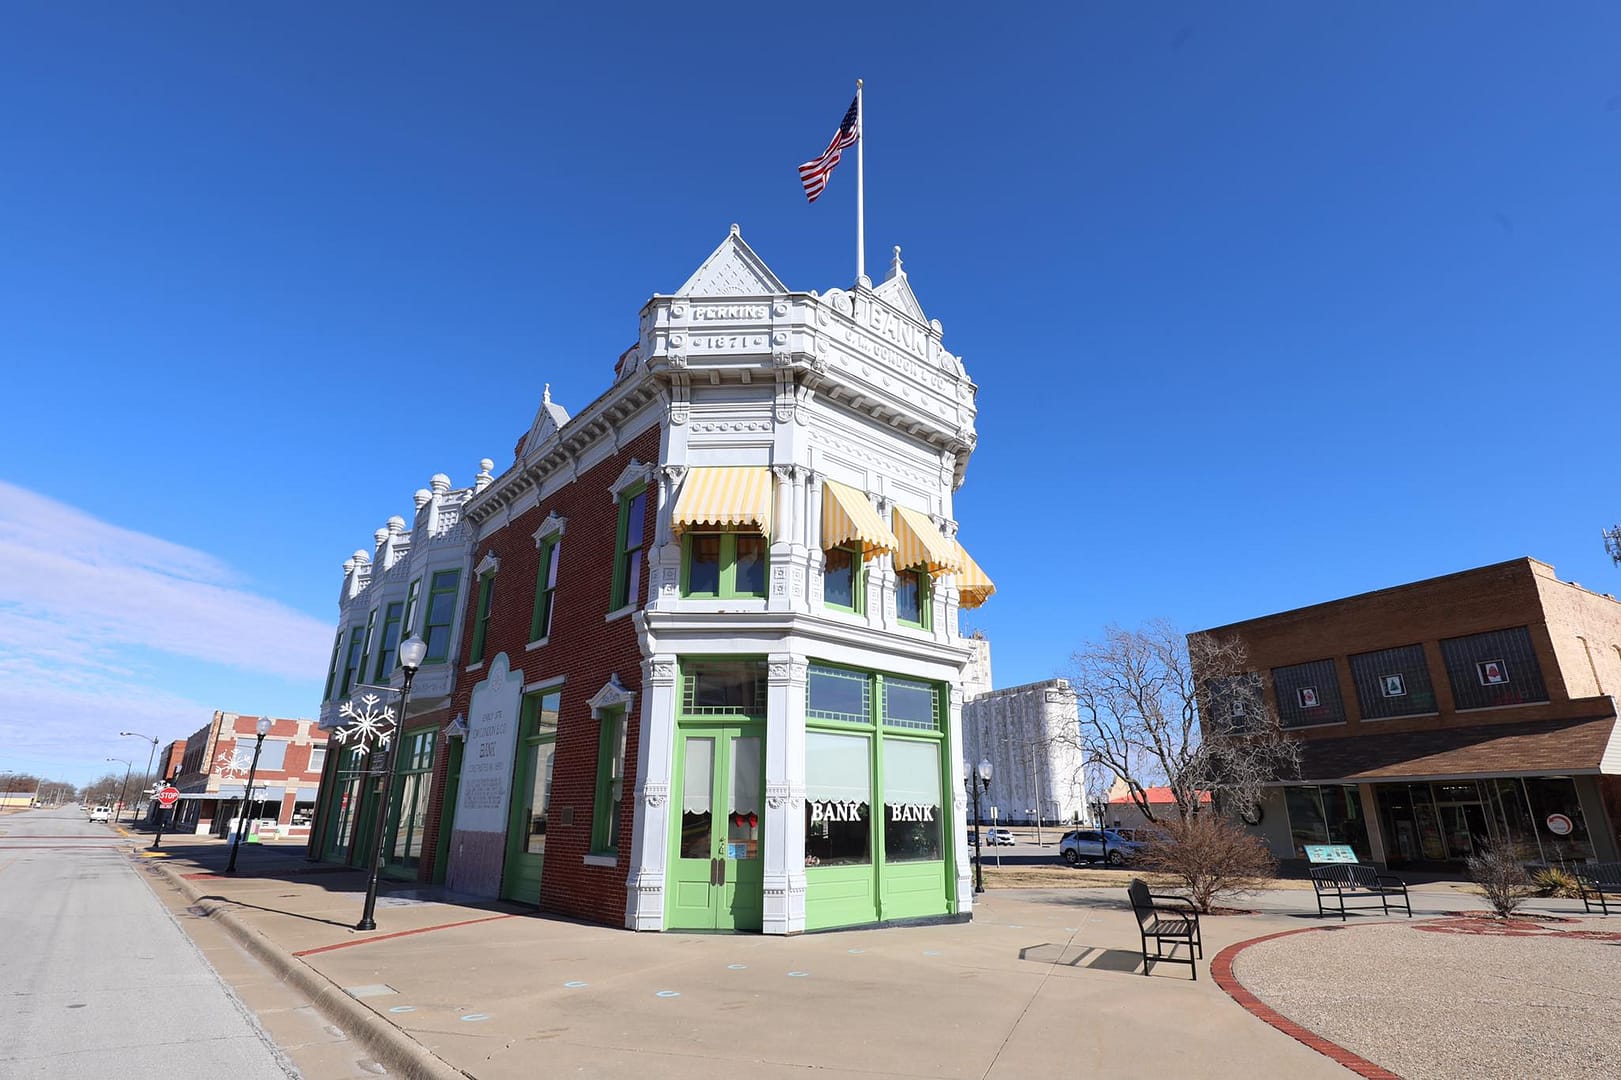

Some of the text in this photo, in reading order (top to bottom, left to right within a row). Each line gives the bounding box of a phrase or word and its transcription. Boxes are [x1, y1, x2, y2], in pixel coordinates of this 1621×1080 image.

[694, 305, 767, 320] PERKINS
[870, 306, 926, 356] BANK
[708, 336, 747, 349] 1871
[873, 343, 917, 377] CONDON
[161, 792, 178, 800] STOP
[811, 802, 934, 822] BANK BANK
